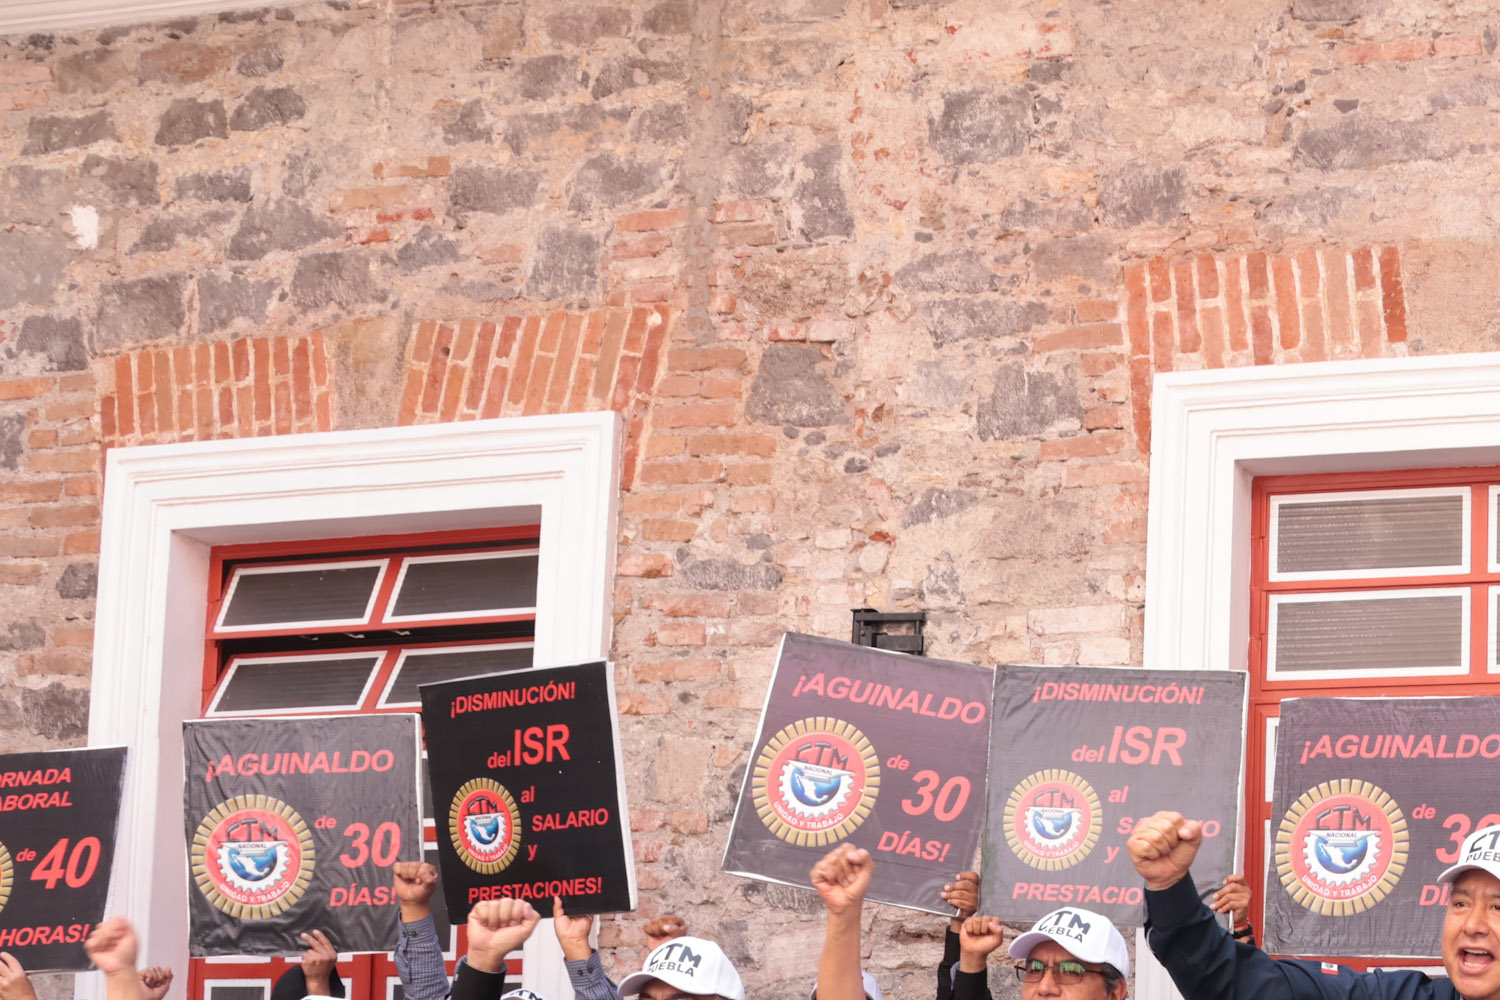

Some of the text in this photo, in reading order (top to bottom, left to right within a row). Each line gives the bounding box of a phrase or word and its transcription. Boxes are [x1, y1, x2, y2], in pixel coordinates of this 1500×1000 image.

[451, 680, 576, 718] ¡DISMINUCIÓN!
[792, 672, 987, 724] ¡AGUINALDO
[1033, 682, 1205, 704] ¡DISMINUCIÓN!
[487, 724, 570, 768] del ISR
[796, 742, 848, 771] CTM
[1072, 726, 1187, 766] del ISR
[206, 750, 395, 782] ¡AGUINALDO
[520, 785, 535, 802] al
[886, 755, 971, 822] de 30
[1034, 789, 1074, 808] CTM
[1108, 786, 1129, 803] al
[468, 797, 497, 815] CTM
[1316, 805, 1371, 831] CTM
[1412, 804, 1437, 819] de
[226, 817, 279, 841] CTM
[532, 808, 609, 831] SALARIO
[315, 815, 401, 868] de 30
[527, 843, 536, 861] y
[877, 830, 951, 862] DÍAS!
[16, 837, 101, 889] de 40
[1104, 846, 1120, 864] y
[329, 882, 395, 907] DÍAS!
[469, 877, 602, 908] PRESTACIONES!
[1012, 882, 1144, 905] PRESTACIO
[650, 944, 702, 967] CTM
